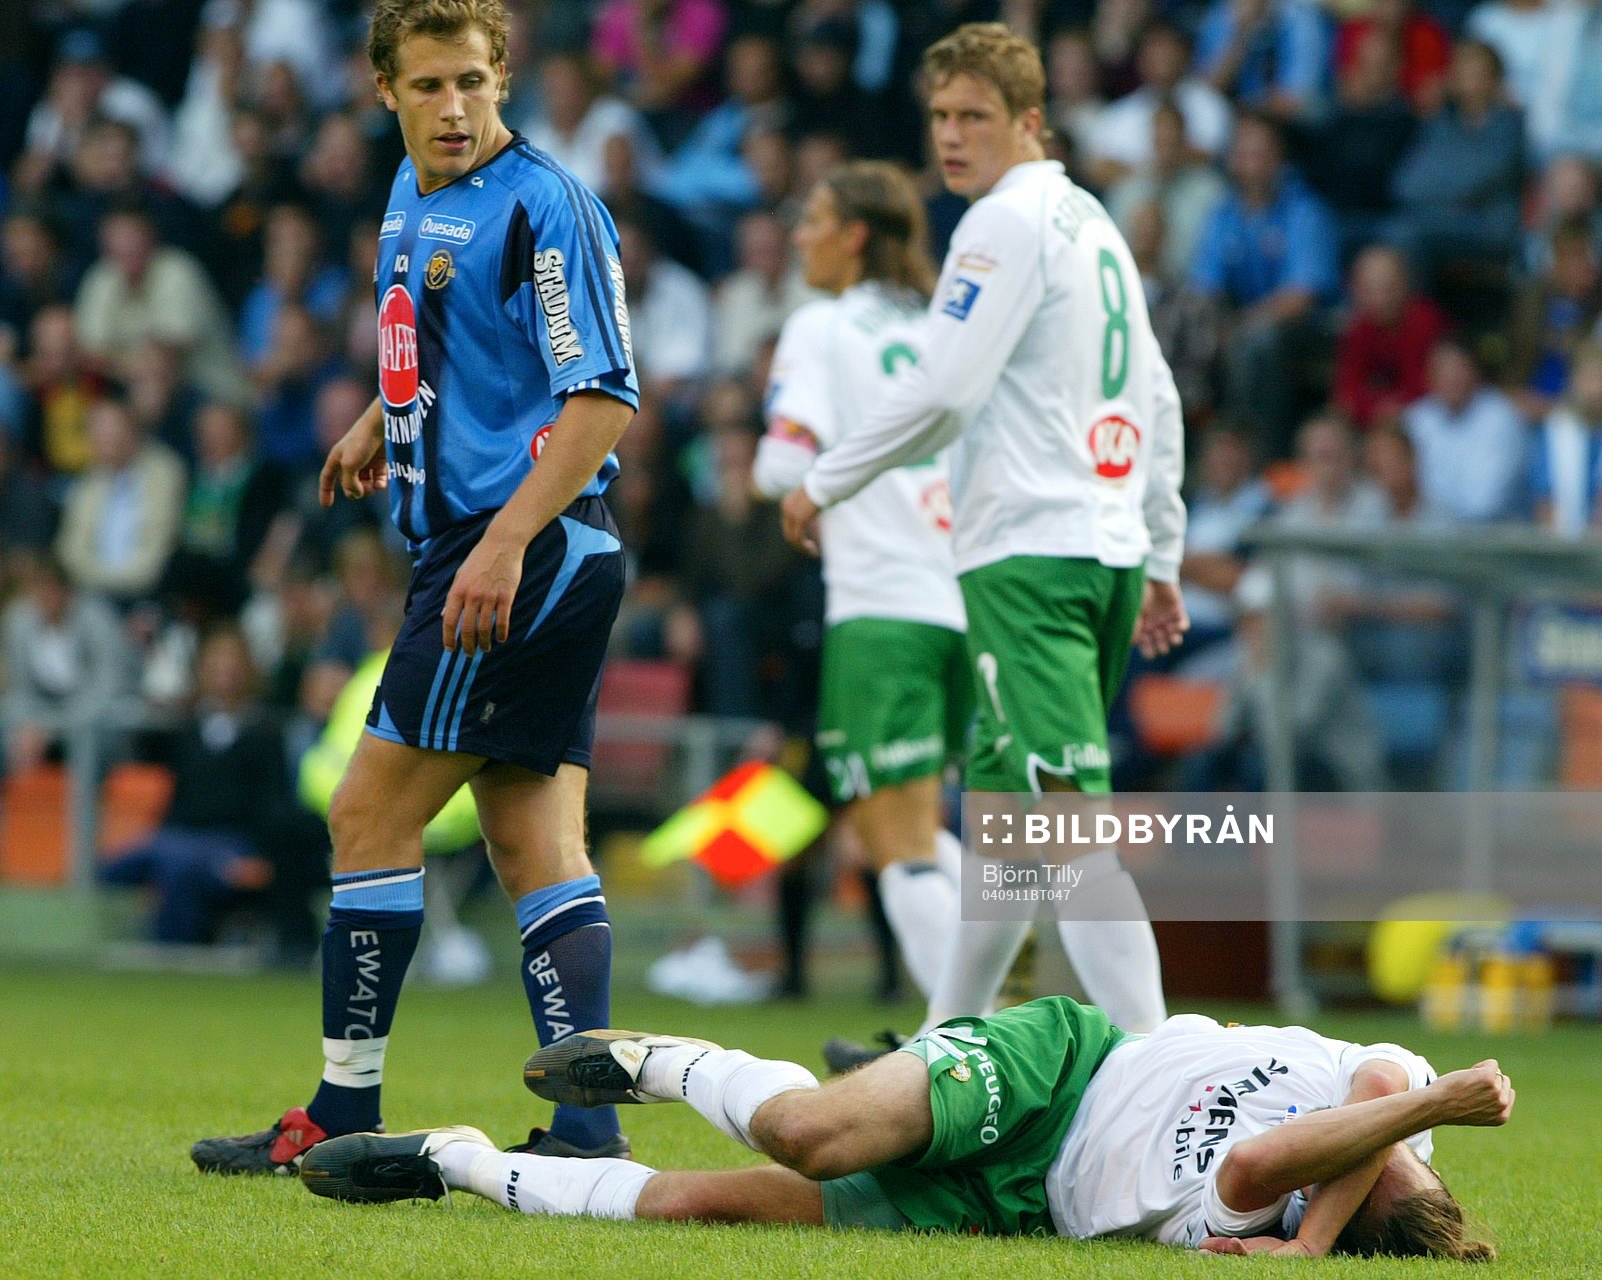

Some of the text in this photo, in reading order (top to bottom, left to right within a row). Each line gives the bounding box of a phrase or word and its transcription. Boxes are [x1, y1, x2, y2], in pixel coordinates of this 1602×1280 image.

[394, 254, 409, 273] ICA
[421, 217, 472, 240] Quesada
[534, 247, 583, 367] STADIUM
[1098, 248, 1130, 400] 8
[528, 950, 575, 1040] BEWA
[968, 1049, 1001, 1145] PEUGEO
